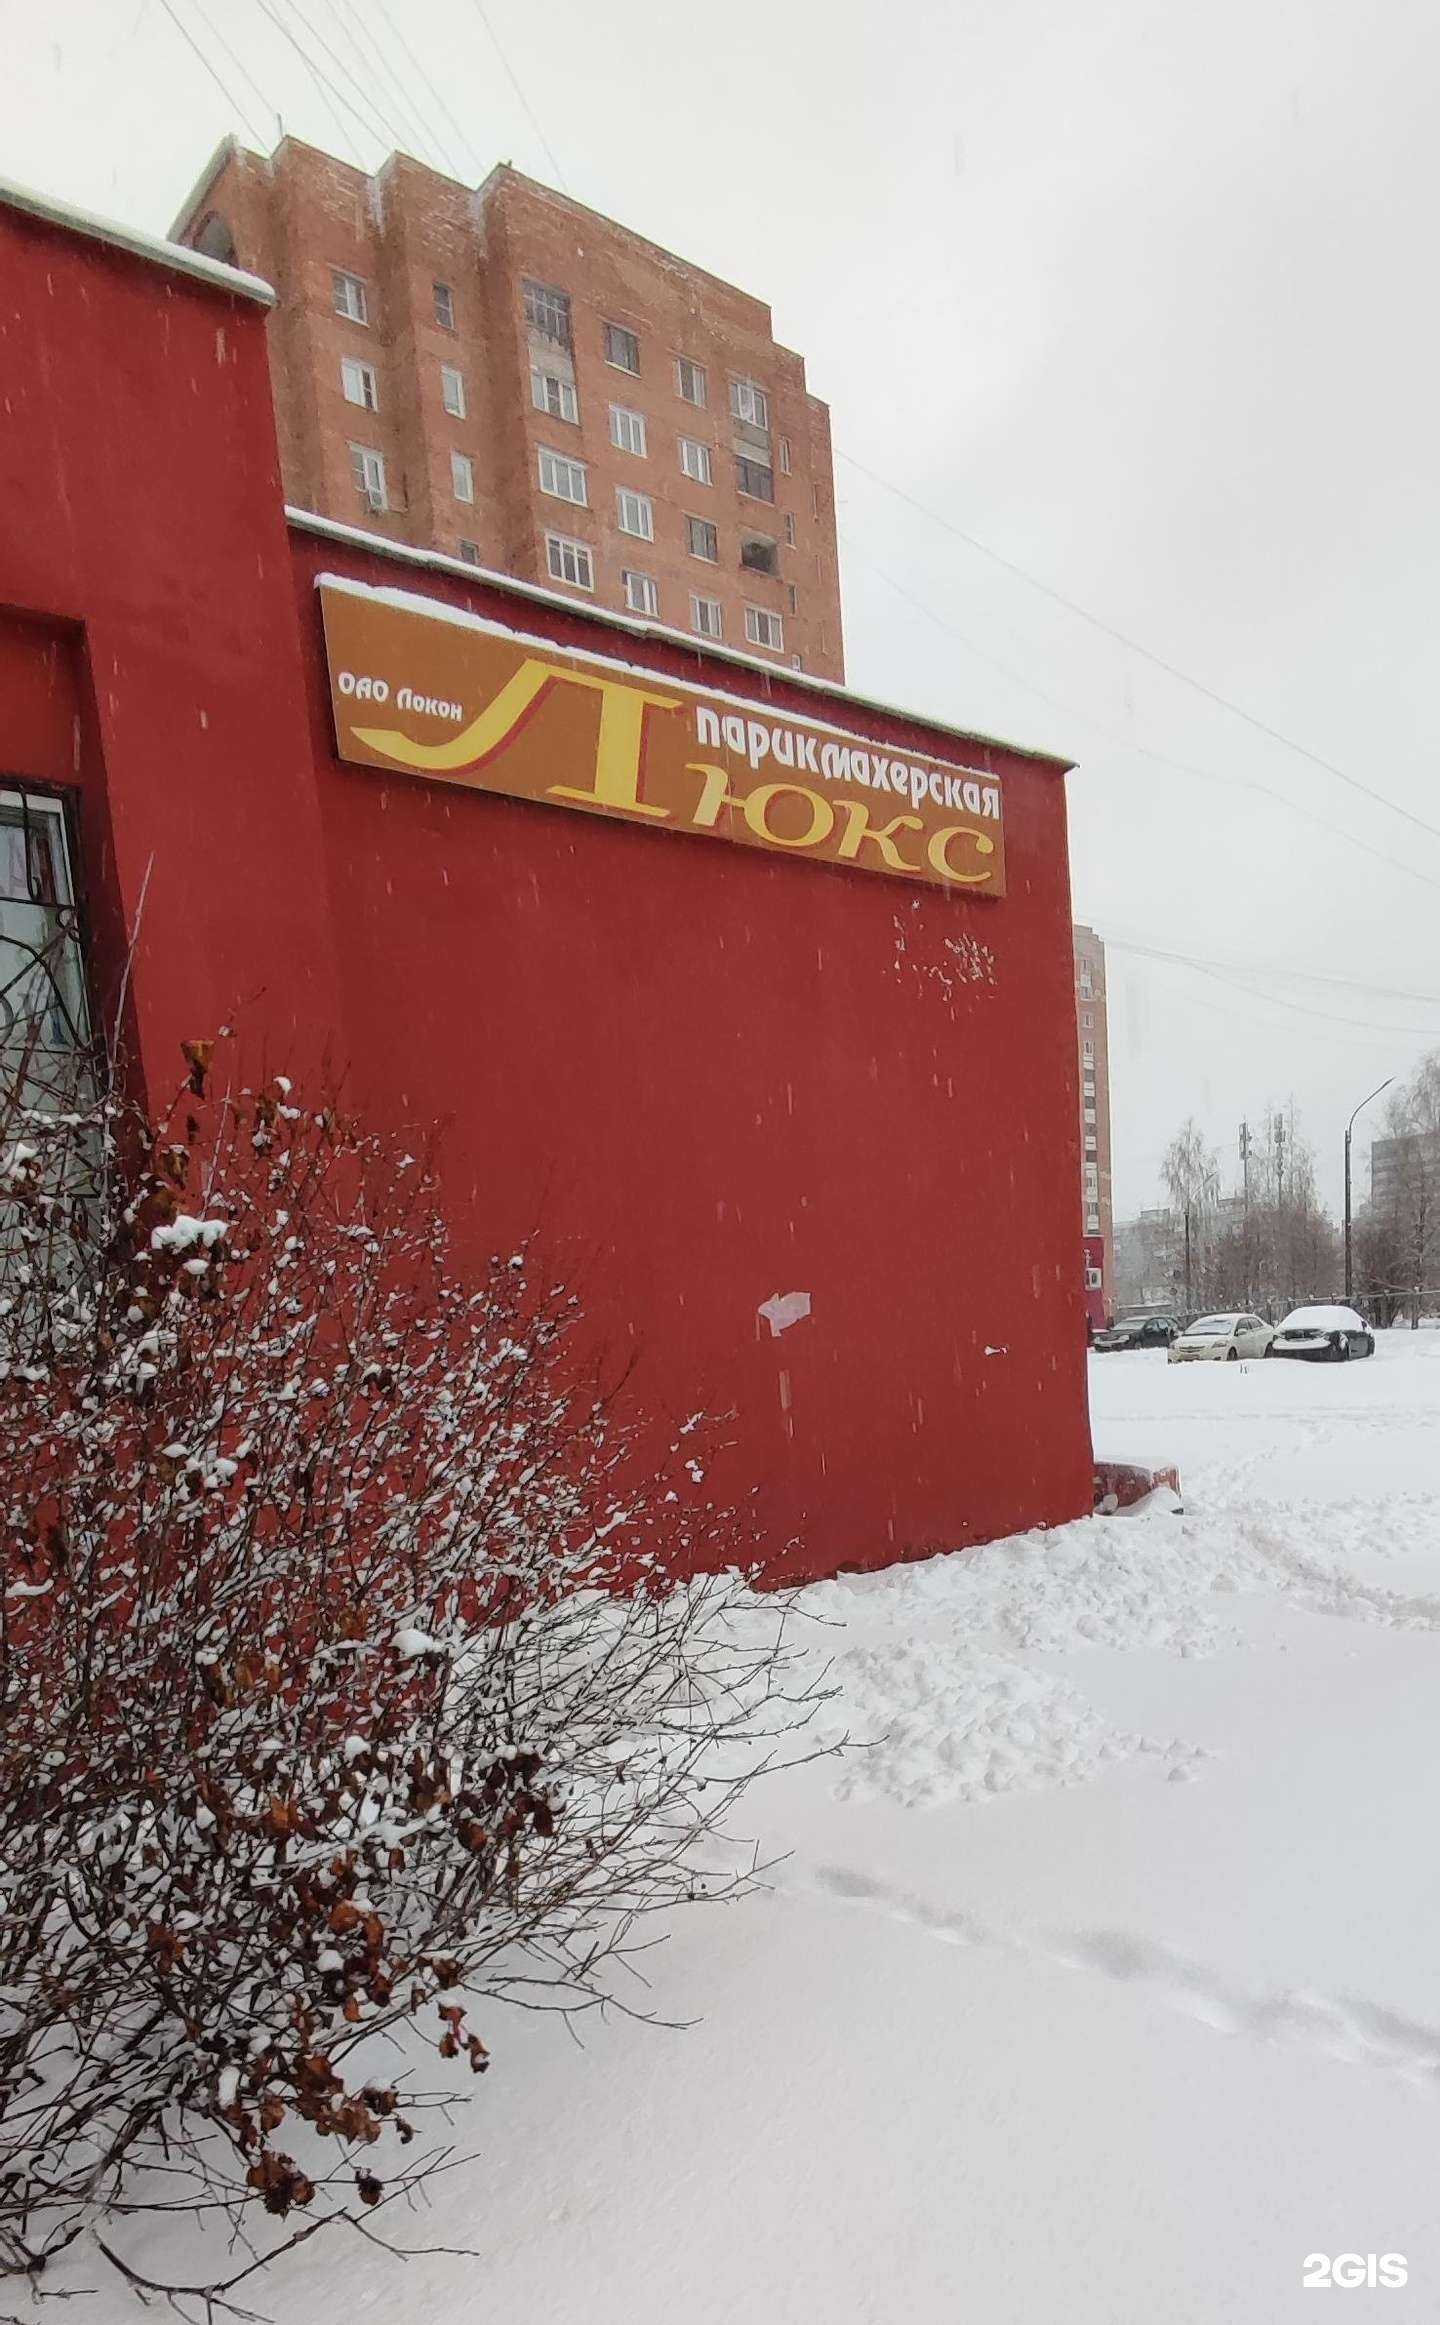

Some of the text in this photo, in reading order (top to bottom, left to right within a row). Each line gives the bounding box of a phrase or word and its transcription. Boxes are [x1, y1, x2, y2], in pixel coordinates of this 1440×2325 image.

[338, 672, 464, 721] ОАО Локон
[696, 706, 1000, 820] парикмахерская
